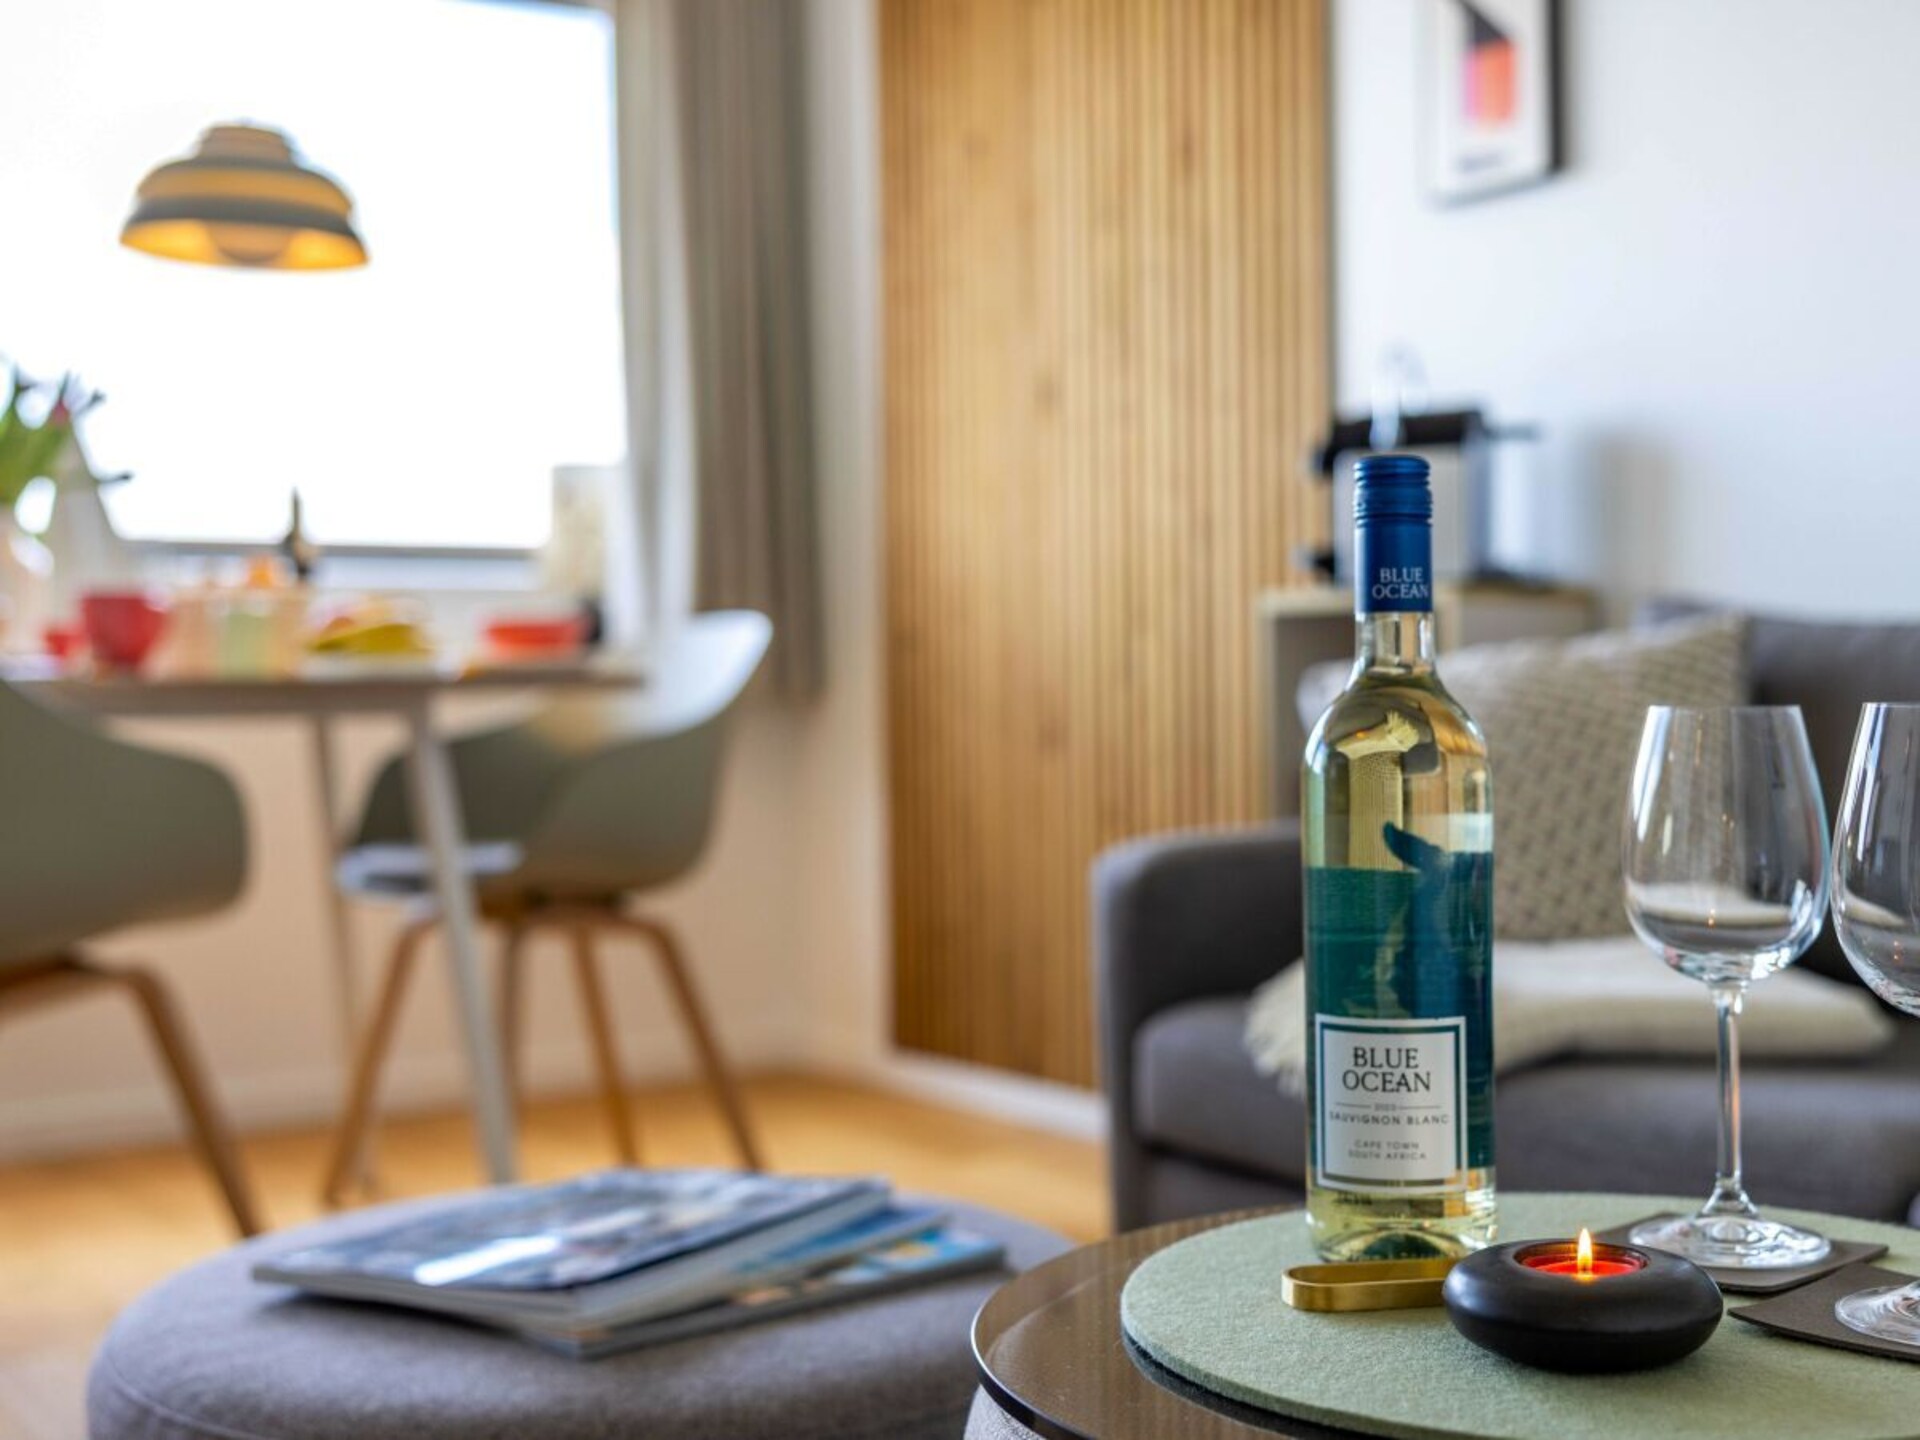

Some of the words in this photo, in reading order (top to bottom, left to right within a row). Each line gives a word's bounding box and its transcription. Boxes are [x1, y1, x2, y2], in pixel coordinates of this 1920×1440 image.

[1379, 567, 1424, 583] BLUE
[1371, 583, 1430, 599] OCEAN
[1353, 1046, 1419, 1068] BLUE
[1342, 1070, 1431, 1092] OCEAN
[1329, 1111, 1401, 1125] SAUVIGNON
[1406, 1114, 1449, 1125] BLANC
[1355, 1140, 1382, 1149] CAPE
[1387, 1141, 1419, 1150] TOWN
[1349, 1150, 1381, 1159] SOUTH
[1386, 1152, 1426, 1160] AFRICA
